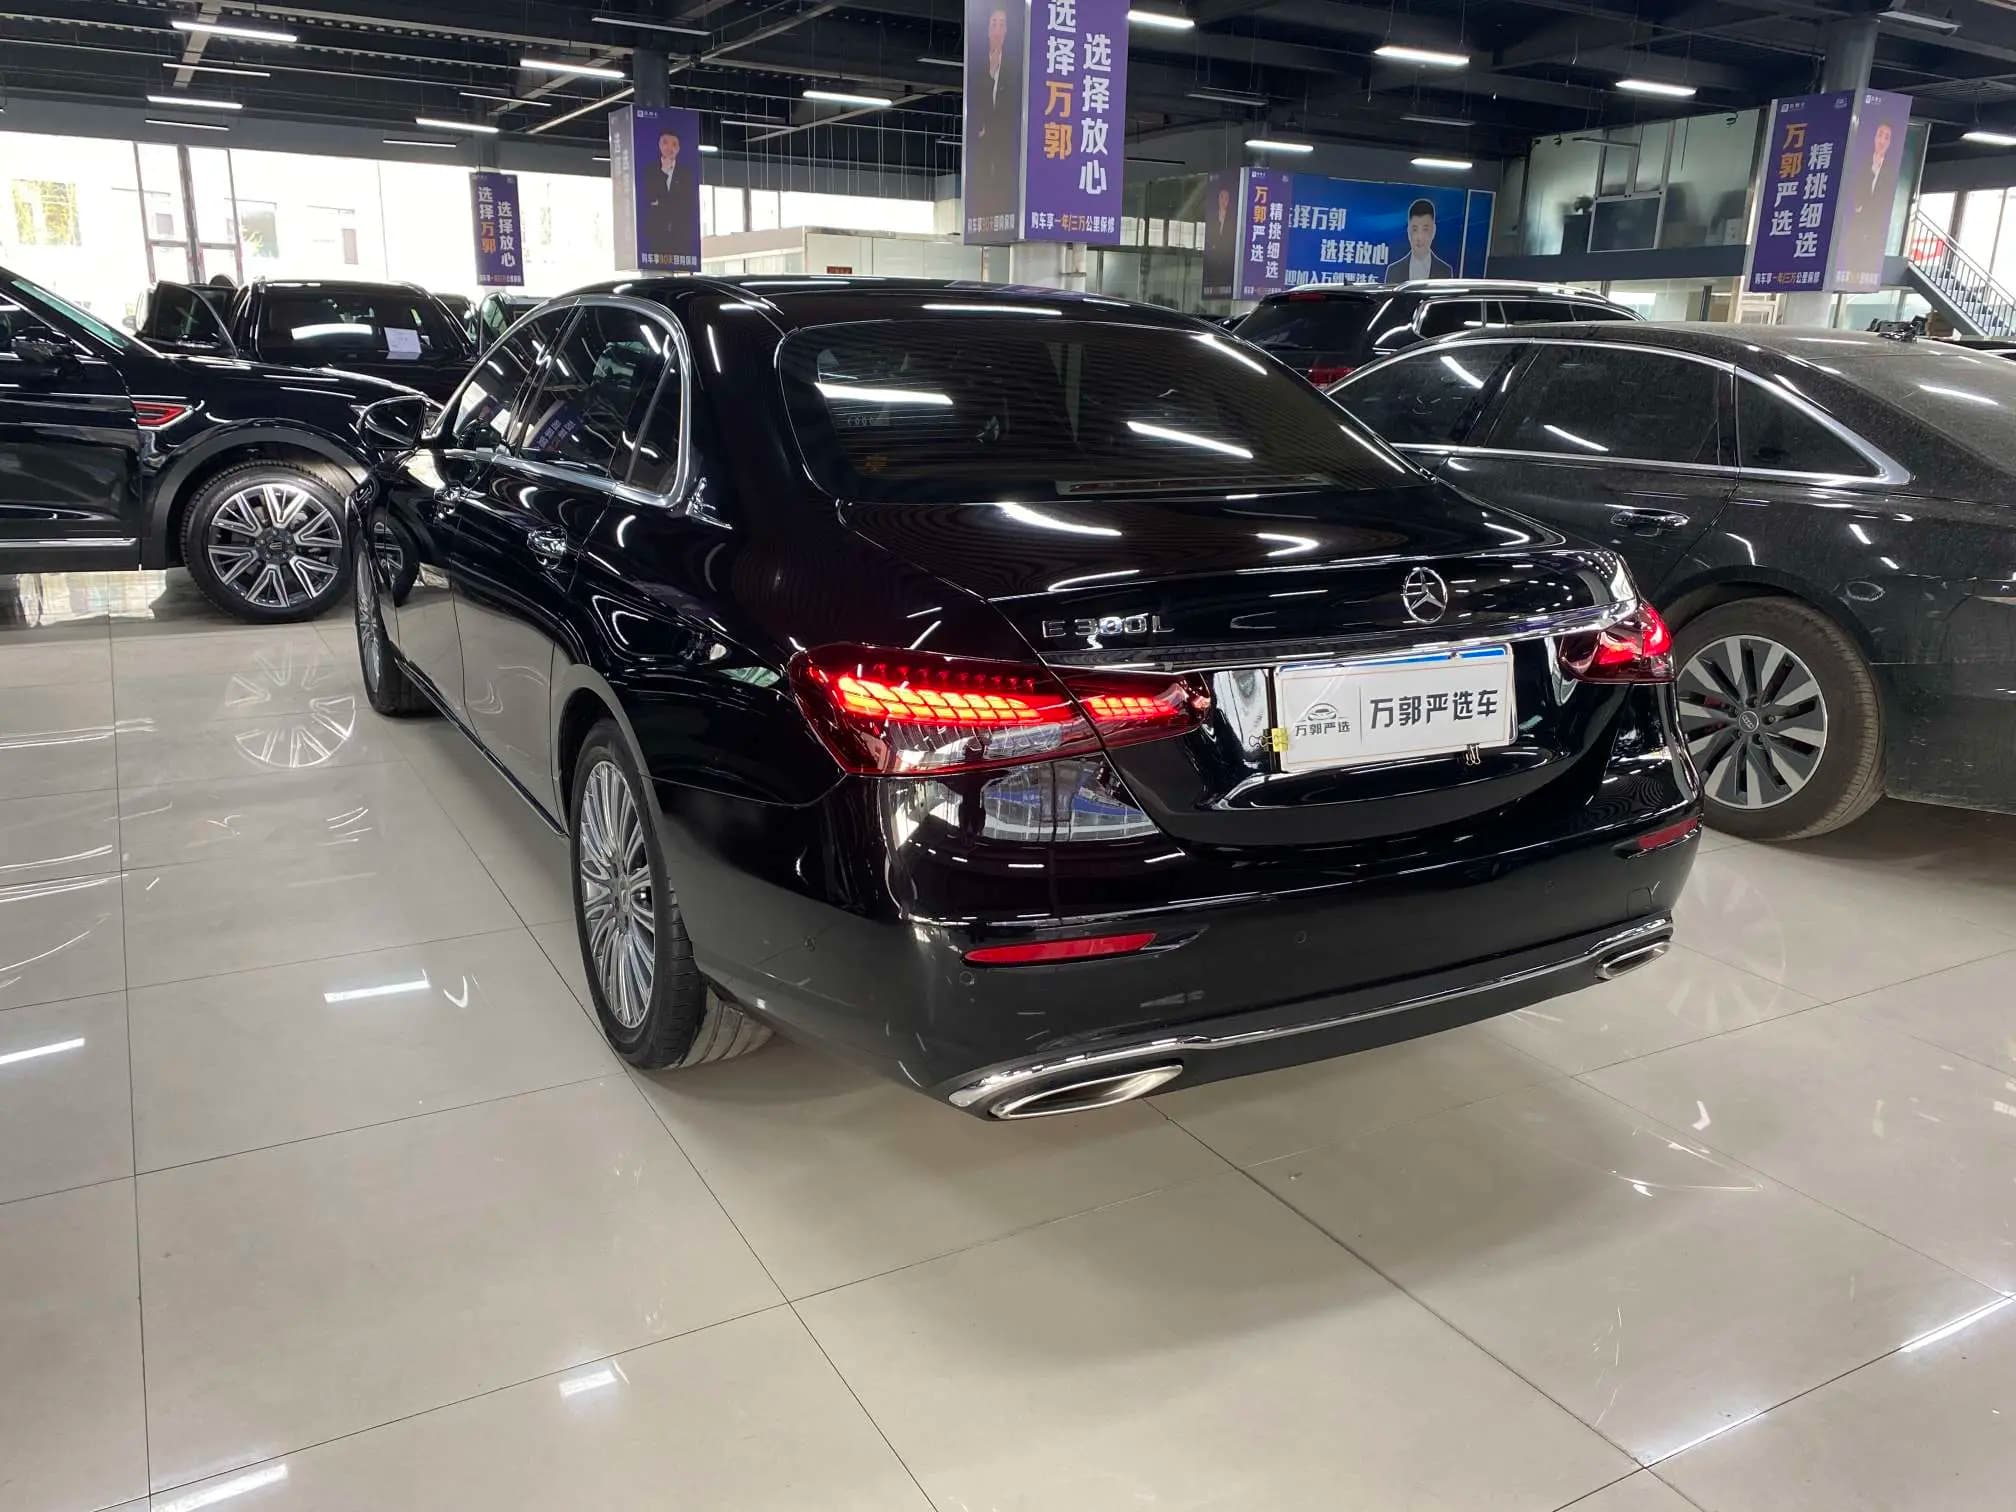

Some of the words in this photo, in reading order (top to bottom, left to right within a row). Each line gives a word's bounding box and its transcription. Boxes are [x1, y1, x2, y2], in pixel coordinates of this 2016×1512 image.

[1043, 0, 1076, 160] 选择万郭
[1079, 33, 1112, 195] 选择放心
[1769, 123, 1808, 237] 万郭严选
[1793, 142, 1834, 258] 精挑细选
[478, 186, 497, 254] 选择万郭
[497, 200, 516, 267] 选择放心
[1250, 186, 1269, 262] 万郭严选
[1265, 202, 1284, 279] 精挑细选
[1320, 238, 1389, 265] 选择放心
[1294, 719, 1351, 737] 万郭严选
[1369, 689, 1498, 729] 万郭严选车
